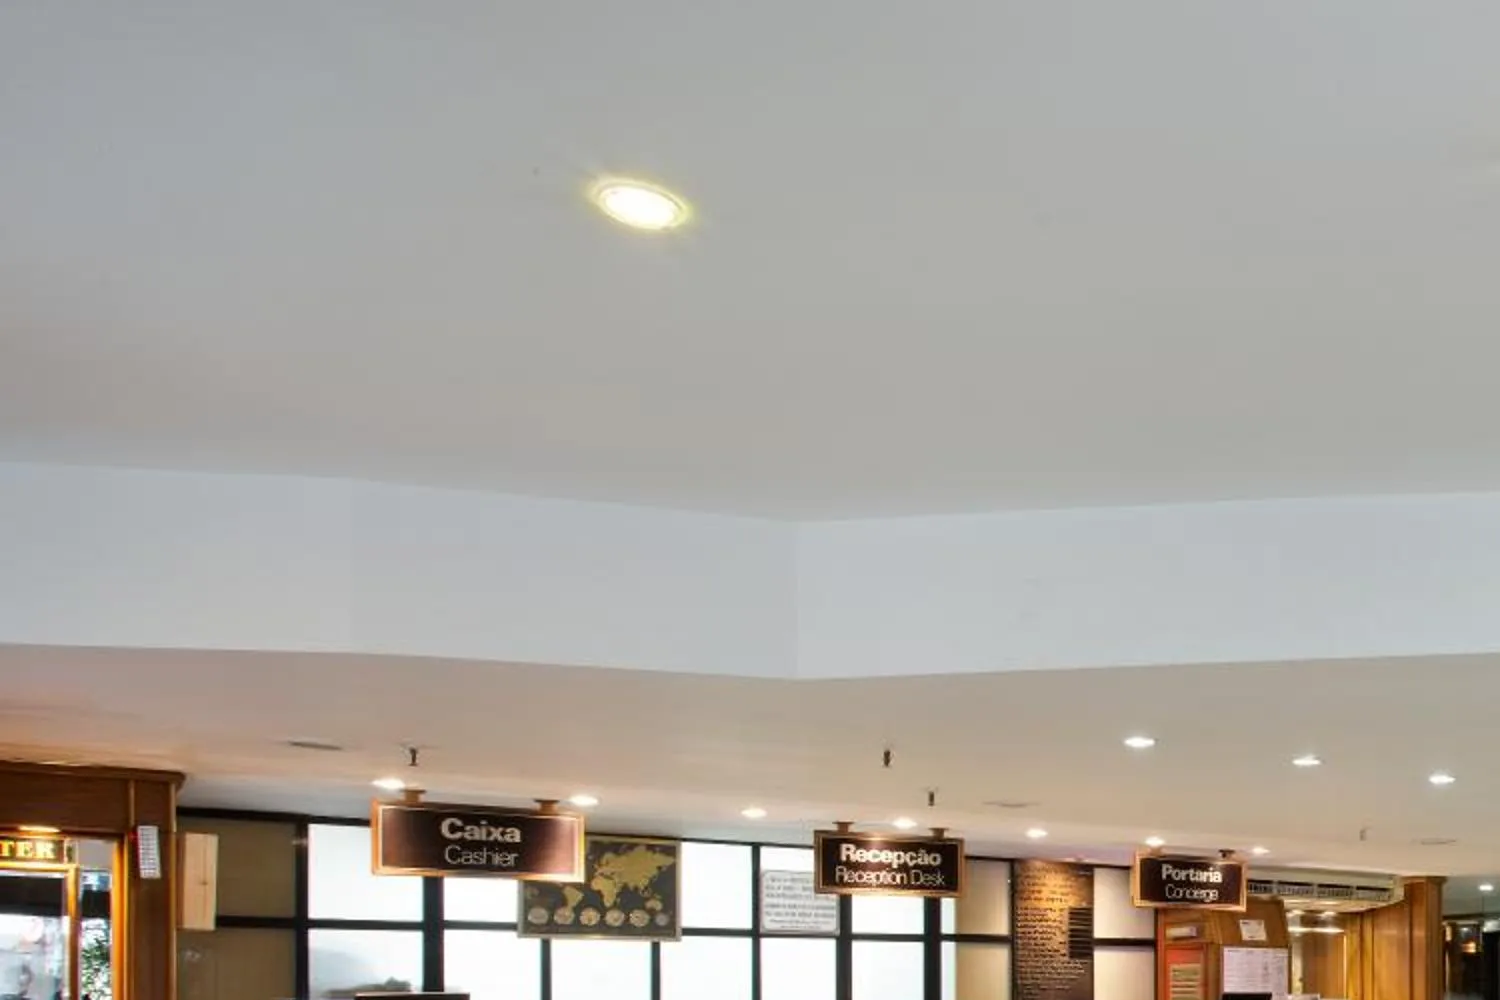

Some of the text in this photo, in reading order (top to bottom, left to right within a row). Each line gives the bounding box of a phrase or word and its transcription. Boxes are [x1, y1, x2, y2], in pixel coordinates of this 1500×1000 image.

[440, 817, 522, 843] Caixa
[444, 845, 520, 867] Cashier
[840, 843, 942, 868] Recepção
[834, 866, 945, 887] Reception Desk
[1161, 863, 1223, 883] Portaria
[1165, 883, 1219, 902] Concierge
